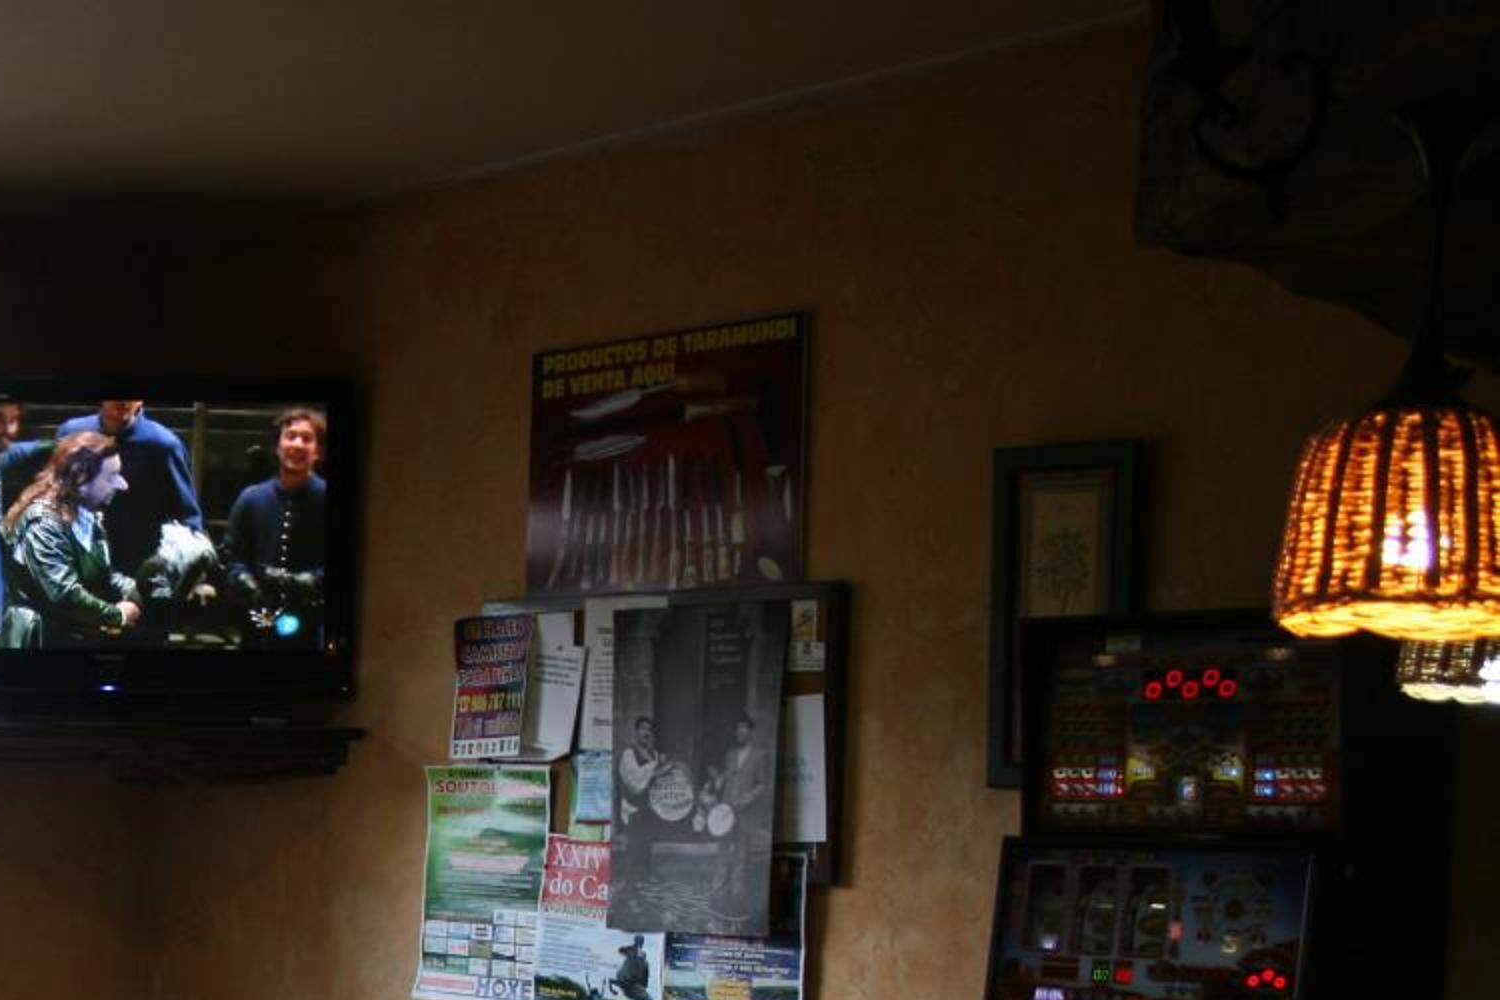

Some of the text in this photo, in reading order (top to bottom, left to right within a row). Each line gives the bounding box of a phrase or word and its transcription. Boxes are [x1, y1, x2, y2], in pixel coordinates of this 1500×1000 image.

[543, 318, 796, 374] PRODUCTOS DE TARAMUNDI
[542, 379, 565, 400] DE
[569, 369, 626, 395] VENTA
[580, 875, 611, 901] Ca
